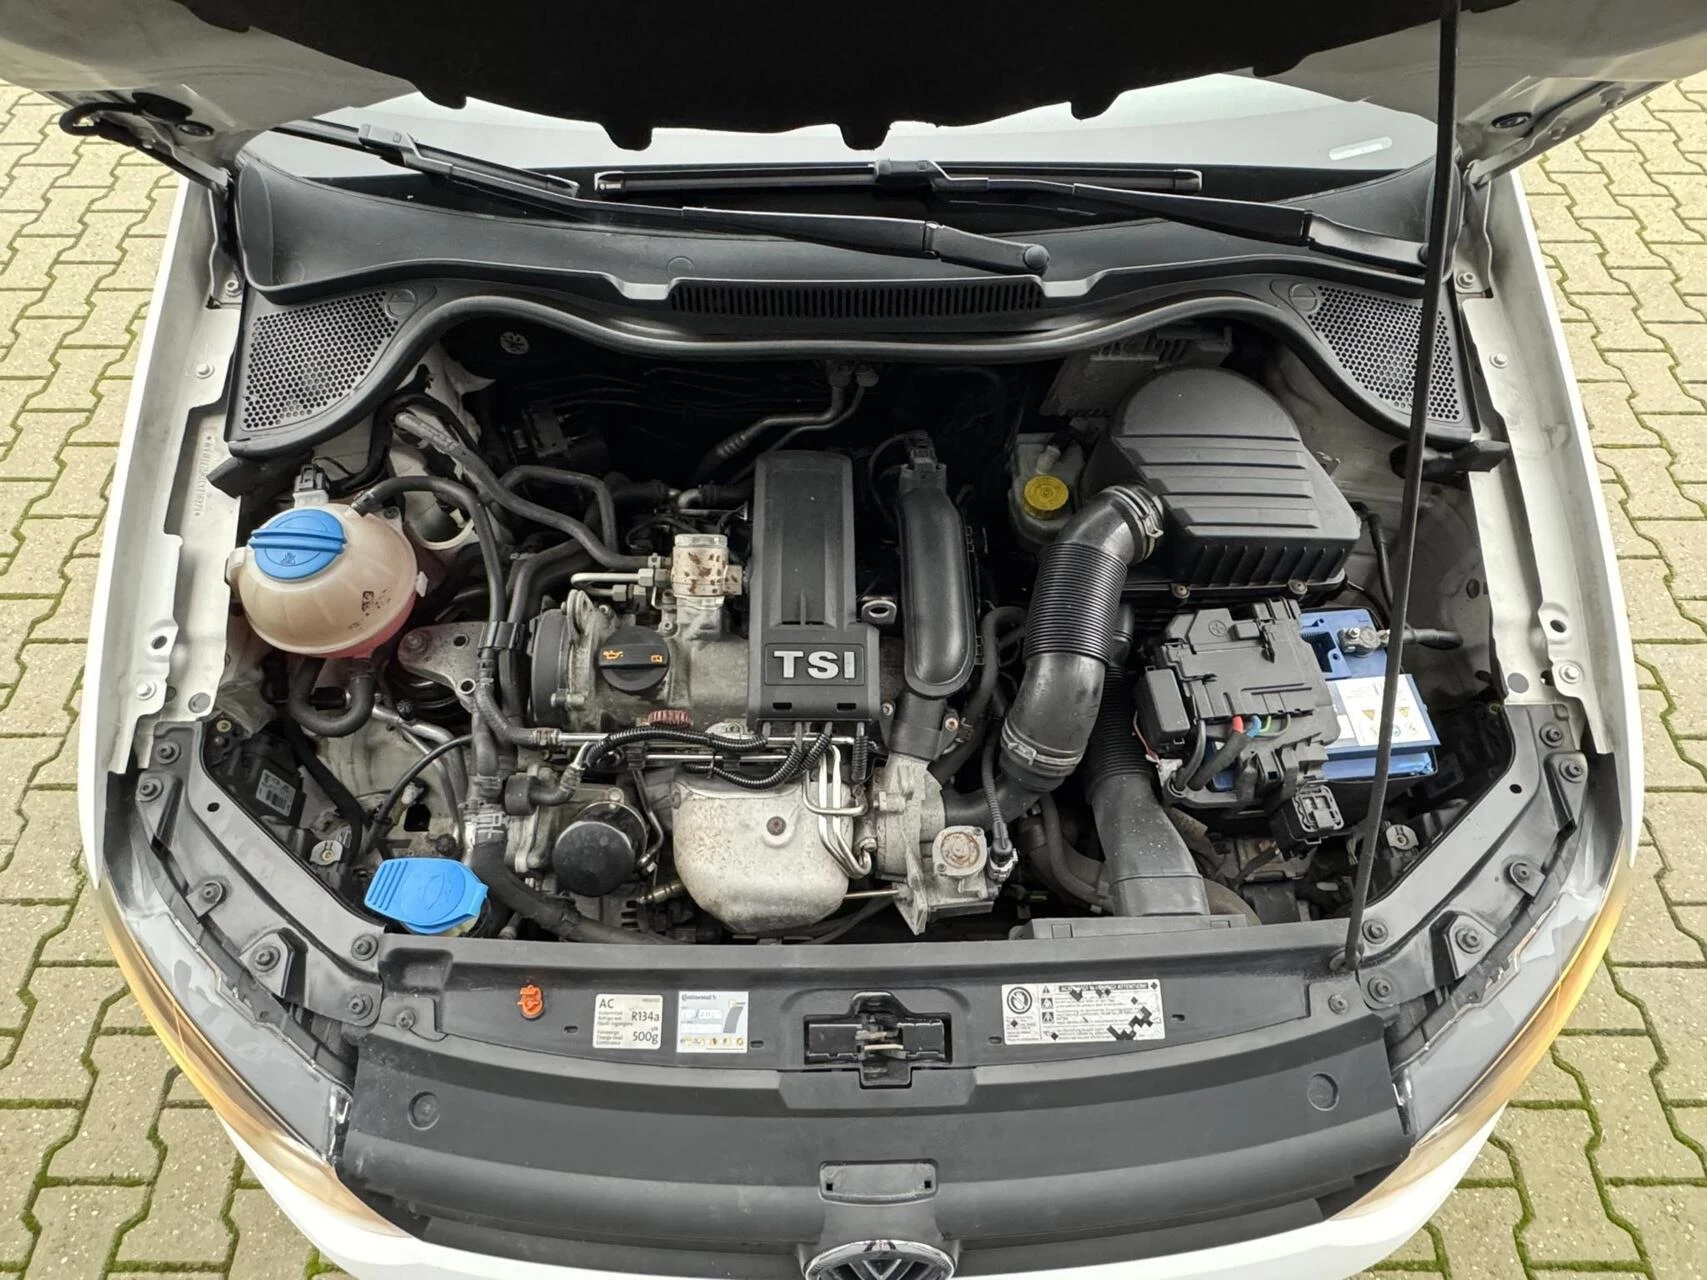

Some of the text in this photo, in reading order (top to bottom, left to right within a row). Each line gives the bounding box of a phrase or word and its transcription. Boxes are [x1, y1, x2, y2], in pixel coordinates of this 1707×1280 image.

[773, 650, 856, 680] TSI
[599, 998, 615, 1009] AC
[632, 1011, 660, 1022] R134a
[633, 1031, 659, 1045] 500g
